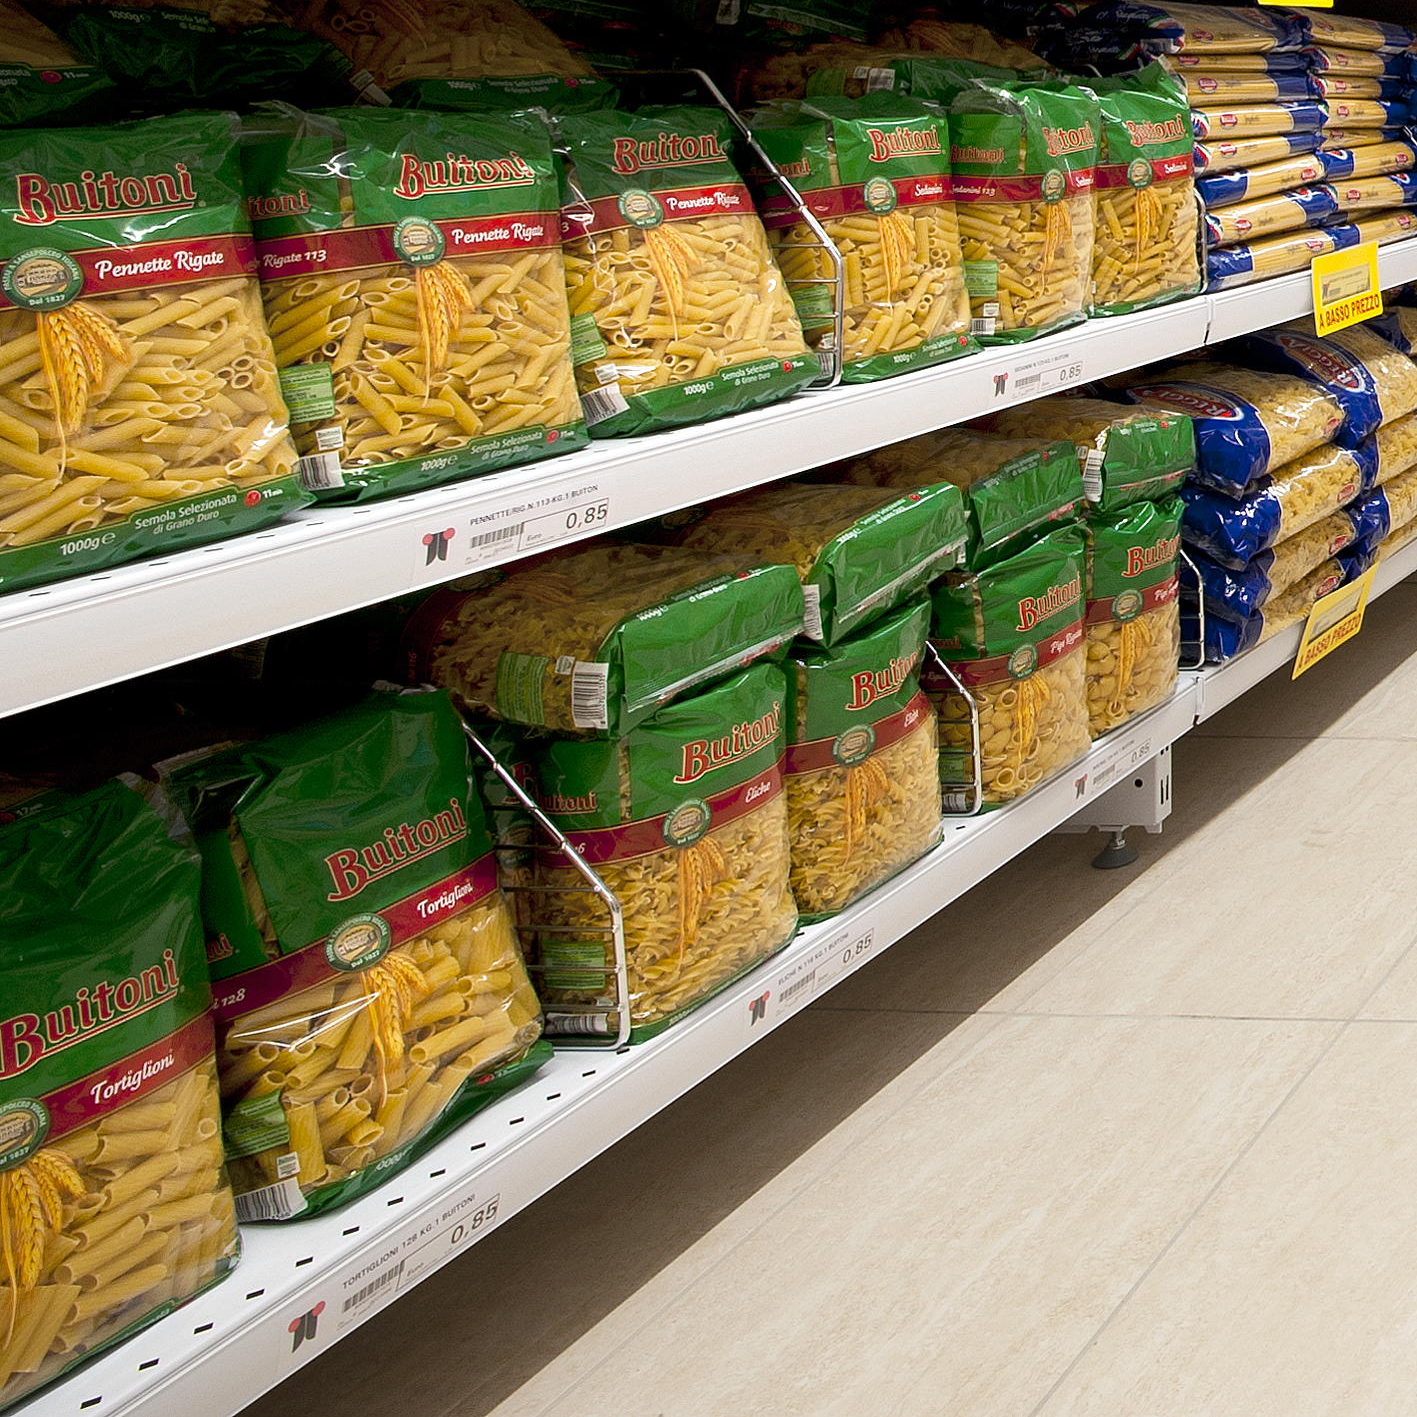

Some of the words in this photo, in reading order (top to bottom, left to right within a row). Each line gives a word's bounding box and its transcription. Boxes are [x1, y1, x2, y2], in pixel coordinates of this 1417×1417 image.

[868, 123, 941, 163] Buitoni
[13, 162, 198, 227] Buitoni
[393, 150, 535, 203] Buitoni
[452, 225, 505, 245] Pennette
[506, 222, 544, 241] Rigate
[95, 256, 172, 280] Pennette
[173, 249, 224, 272] Rigate
[1319, 313, 1325, 328] A
[1325, 303, 1350, 327] BASSO
[1351, 293, 1381, 317] PREZZO
[1059, 365, 1081, 382] 0,85
[135, 508, 180, 530] Semola
[181, 492, 237, 518] Selezionata
[566, 503, 608, 529] 0,85
[1018, 575, 1082, 632] Buitoni
[675, 700, 780, 784] Buitoni
[744, 780, 772, 805] Eliche
[328, 796, 468, 903] Buitoni
[842, 934, 872, 964] 0,85
[221, 988, 246, 1006] 128
[90, 1049, 175, 1105] Tortiglioni
[450, 1200, 498, 1244] 0,85
[342, 1247, 399, 1290] TORTIGLIONI
[402, 1233, 417, 1249] 128
[420, 1219, 440, 1237] KG.1
[442, 1194, 475, 1221] BUITONI
